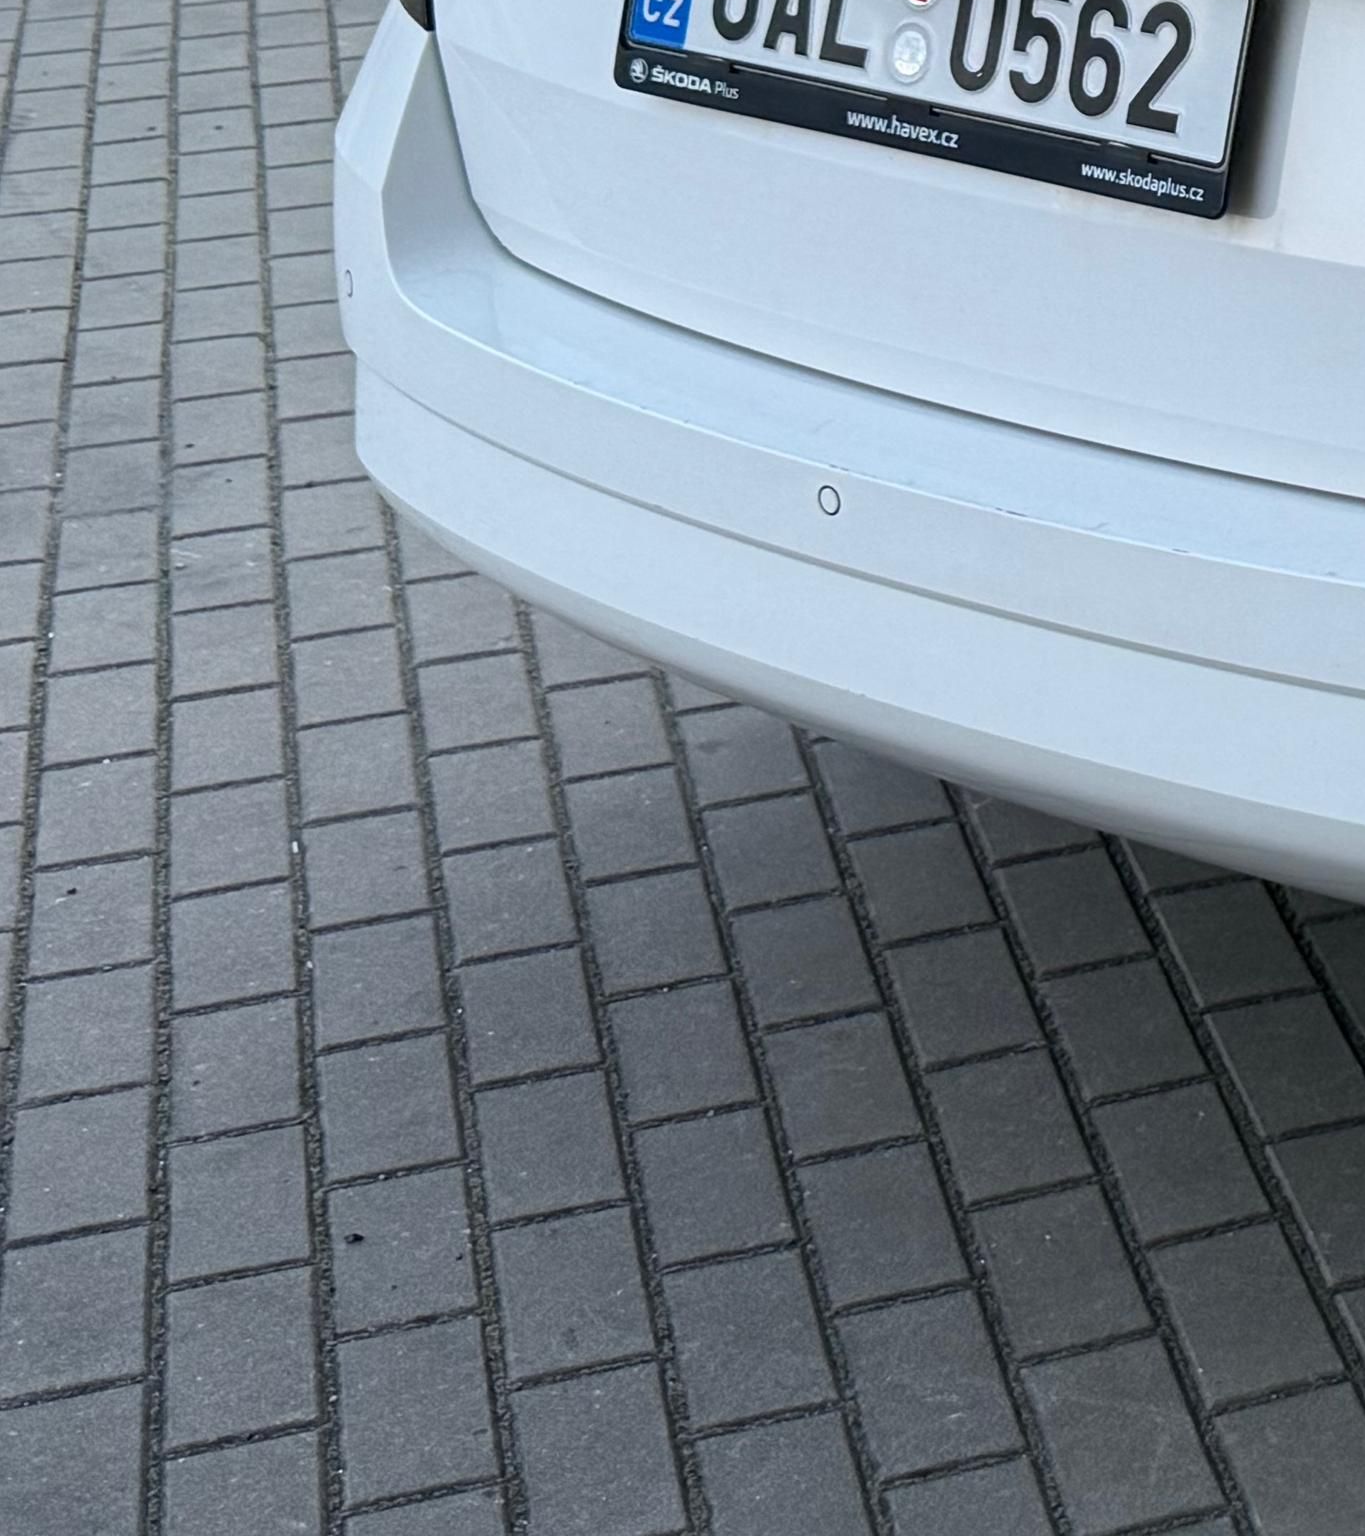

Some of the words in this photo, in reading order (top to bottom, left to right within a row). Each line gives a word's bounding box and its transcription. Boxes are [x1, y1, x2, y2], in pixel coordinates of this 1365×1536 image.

[650, 64, 712, 94] ŠKODA
[714, 79, 740, 100] Plus
[845, 110, 960, 149] www.havex.cz
[1080, 162, 1205, 202] www.skodaplus.cz
